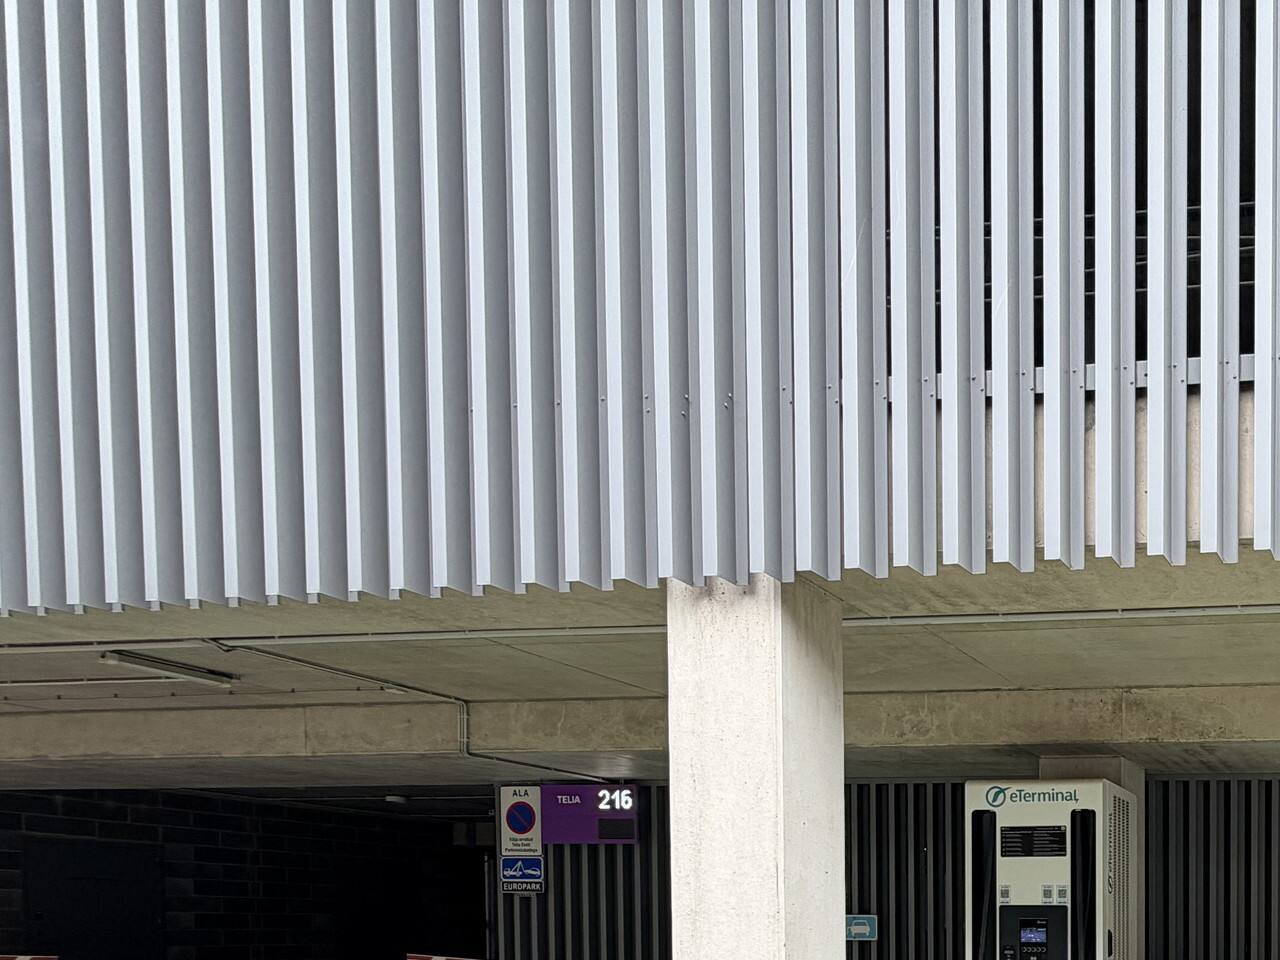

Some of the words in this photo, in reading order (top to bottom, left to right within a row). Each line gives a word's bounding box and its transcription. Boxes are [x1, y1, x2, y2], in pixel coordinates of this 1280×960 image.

[512, 789, 529, 798] ALA
[557, 795, 581, 804] TELIA
[598, 789, 633, 810] 216
[1009, 788, 1080, 804] eTerminal
